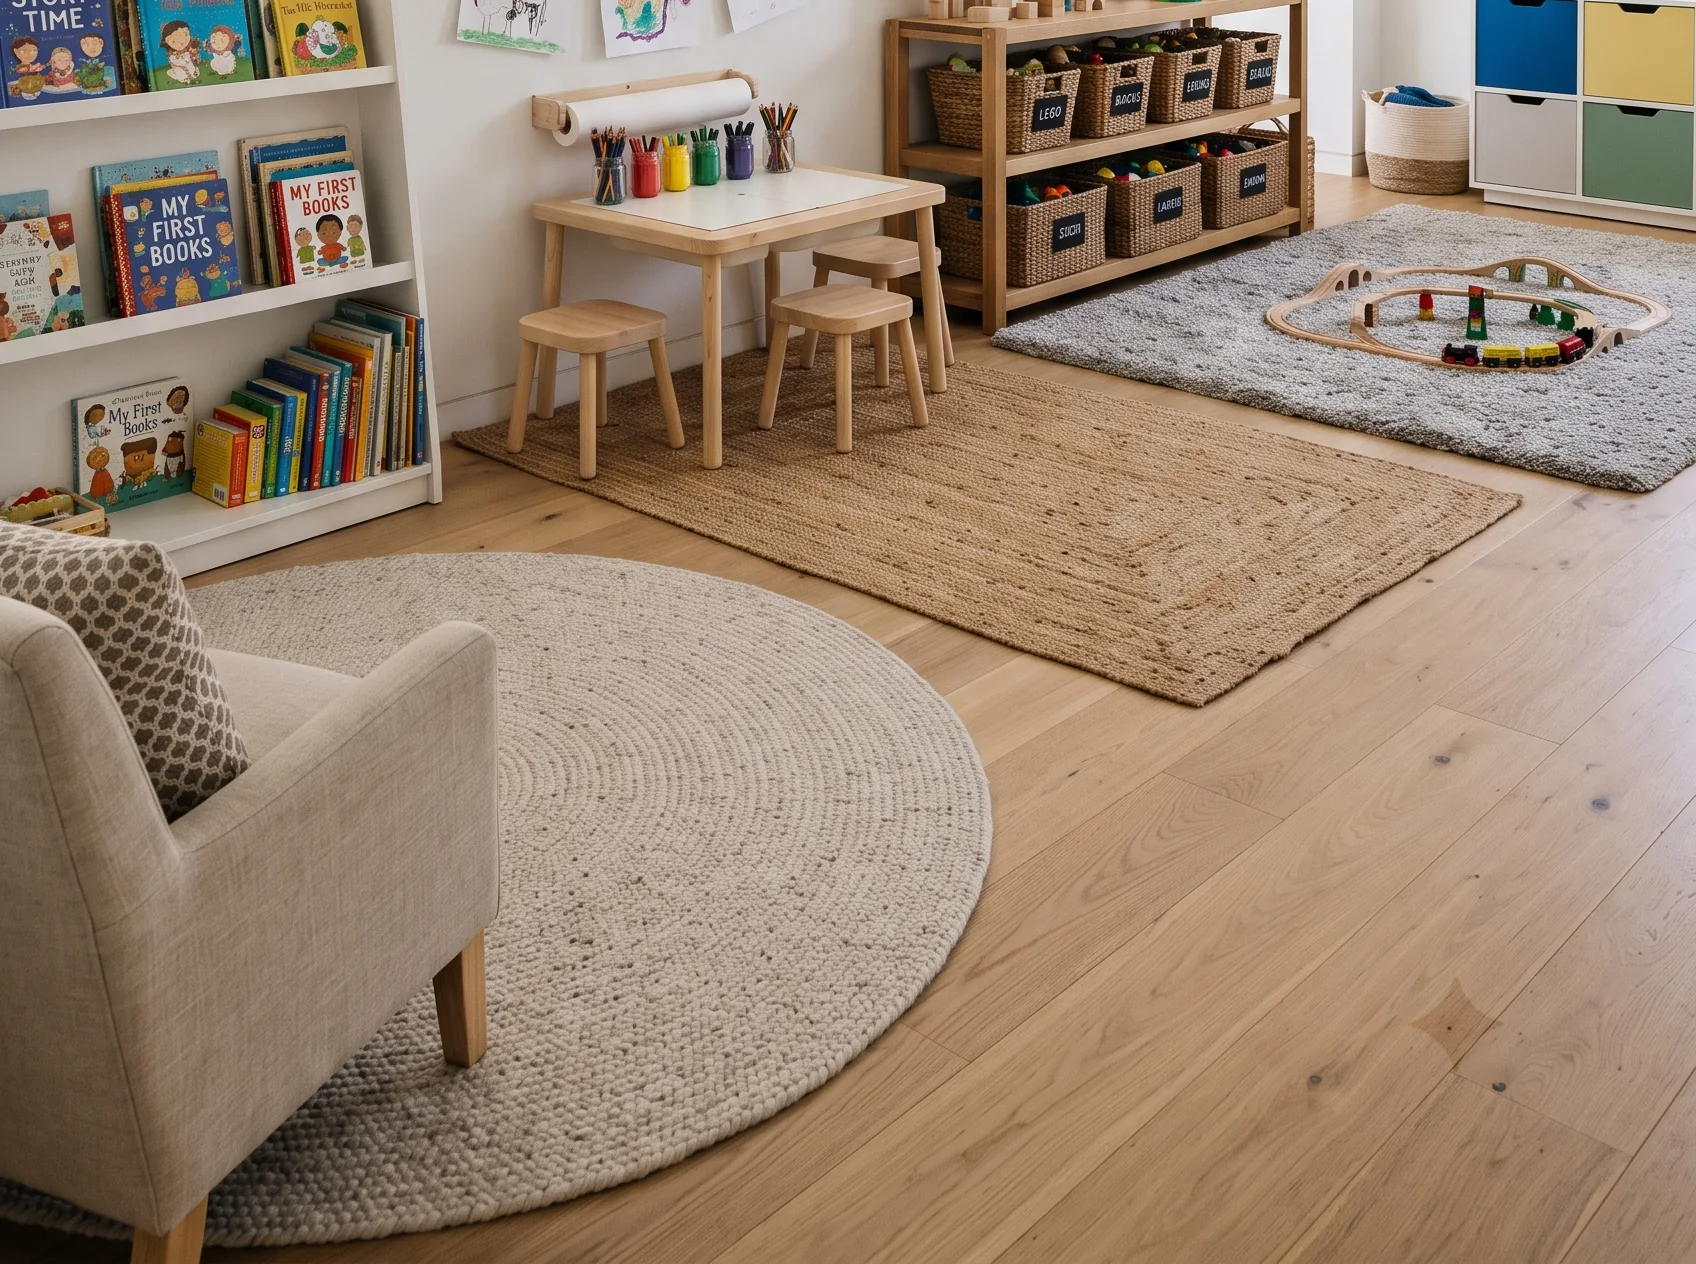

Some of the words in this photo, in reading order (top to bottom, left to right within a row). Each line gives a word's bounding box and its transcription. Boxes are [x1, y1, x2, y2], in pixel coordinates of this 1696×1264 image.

[23, 7, 84, 32] TIME
[289, 183, 311, 201] MY
[317, 176, 357, 197] FIRST
[161, 194, 189, 218] MY
[302, 195, 350, 217] BOOKS
[152, 214, 206, 242] FIRST
[150, 237, 213, 267] BOOKS
[108, 407, 130, 427] My
[133, 401, 162, 420] First
[122, 418, 158, 437] Books
